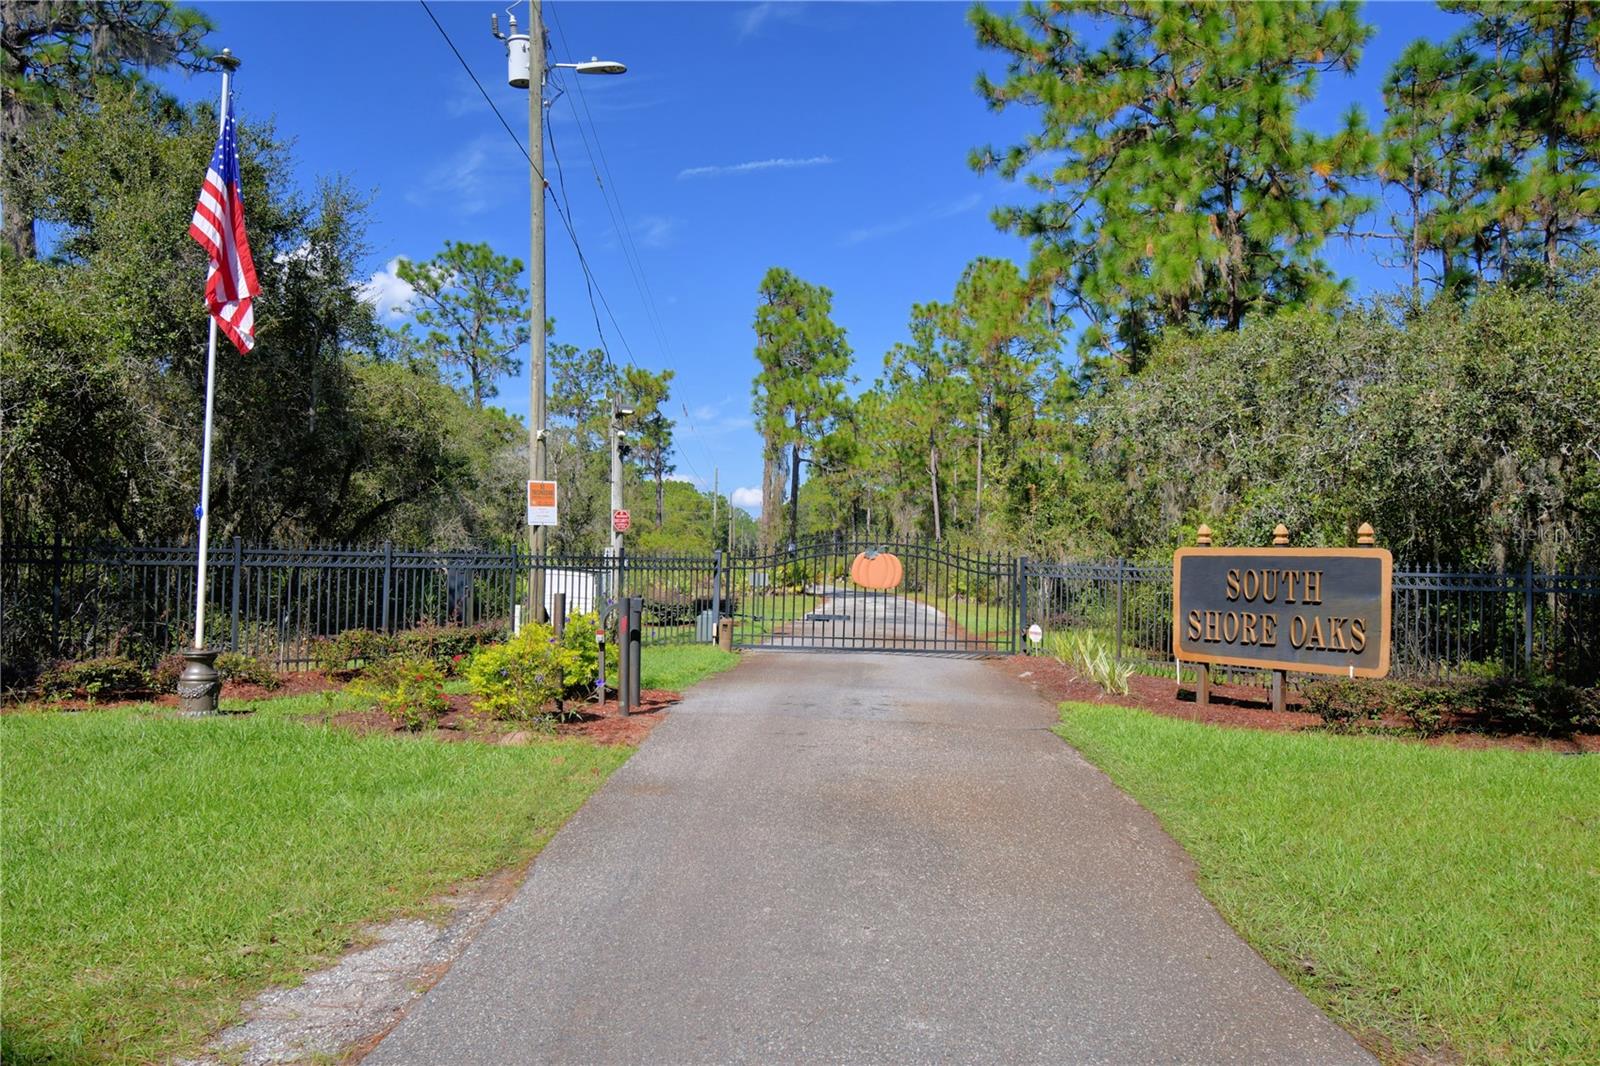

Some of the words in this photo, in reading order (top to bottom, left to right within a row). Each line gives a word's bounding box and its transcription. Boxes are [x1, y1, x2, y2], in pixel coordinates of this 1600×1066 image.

[1226, 568, 1323, 605] SOUTH
[1188, 609, 1278, 647] SHORE
[1290, 615, 1366, 655] OAKS
